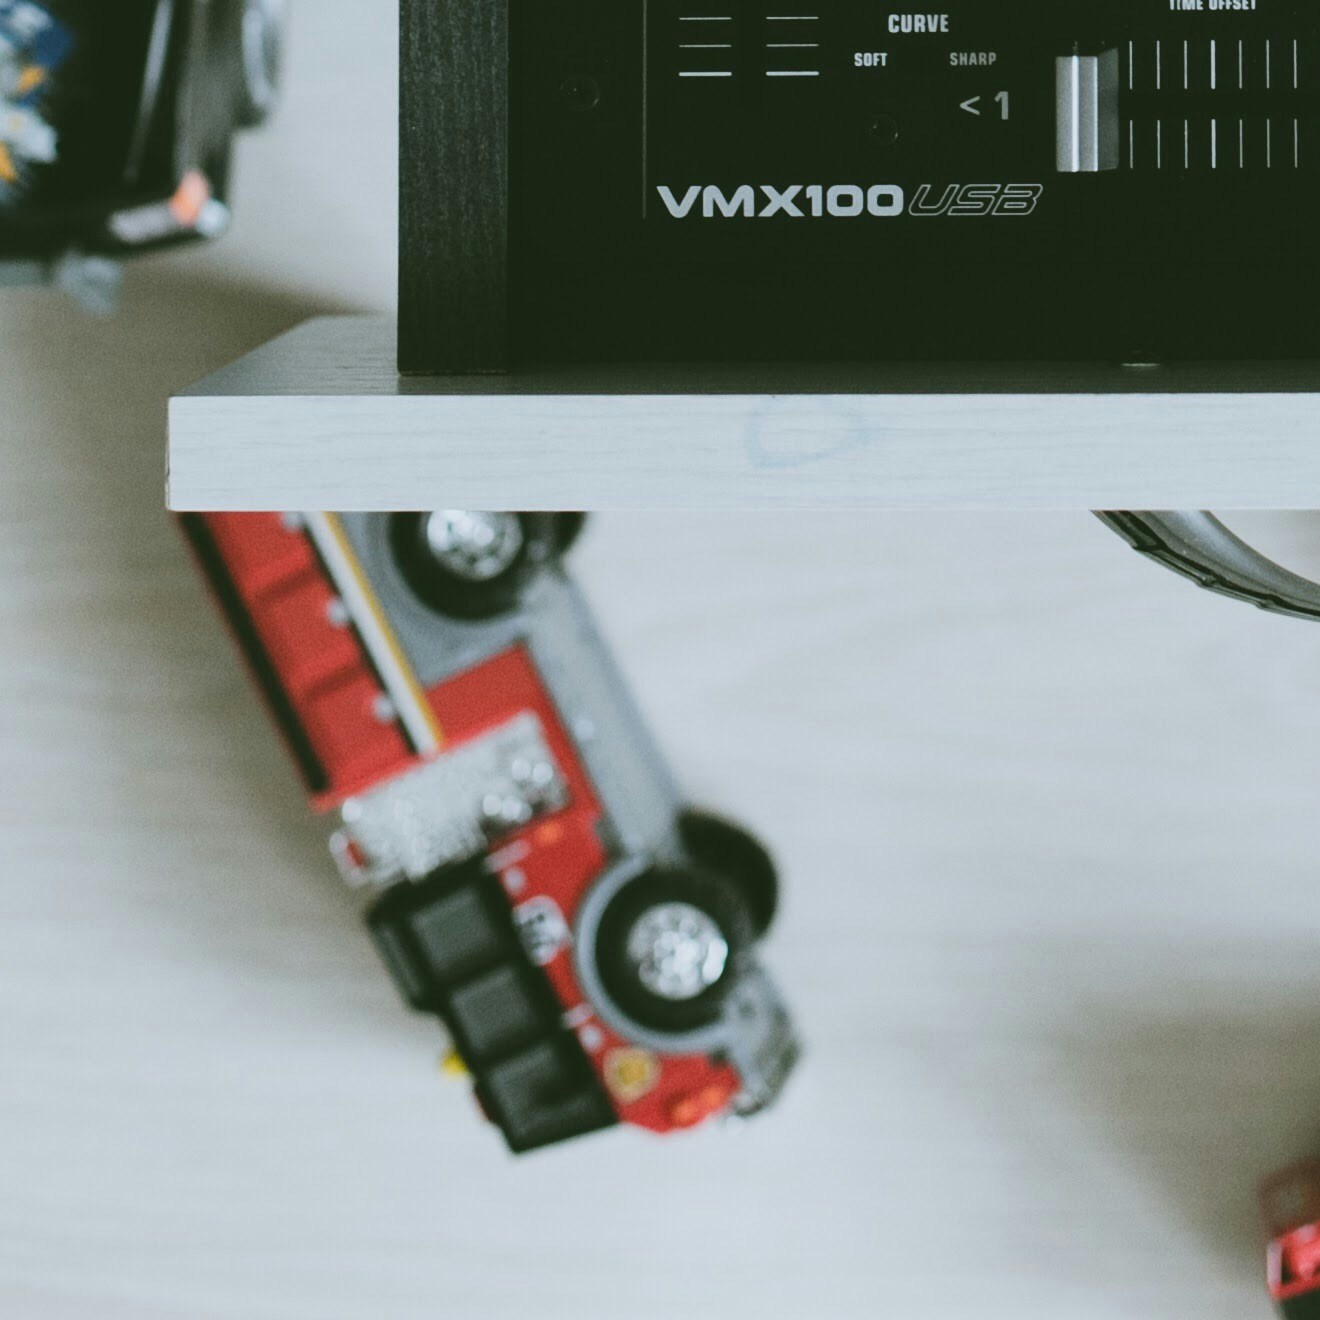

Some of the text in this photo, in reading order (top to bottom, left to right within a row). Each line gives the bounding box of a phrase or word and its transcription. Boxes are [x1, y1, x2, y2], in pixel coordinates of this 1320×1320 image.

[887, 13, 949, 34] CURVE
[853, 52, 888, 67] SOFT
[949, 51, 997, 66] SHARP
